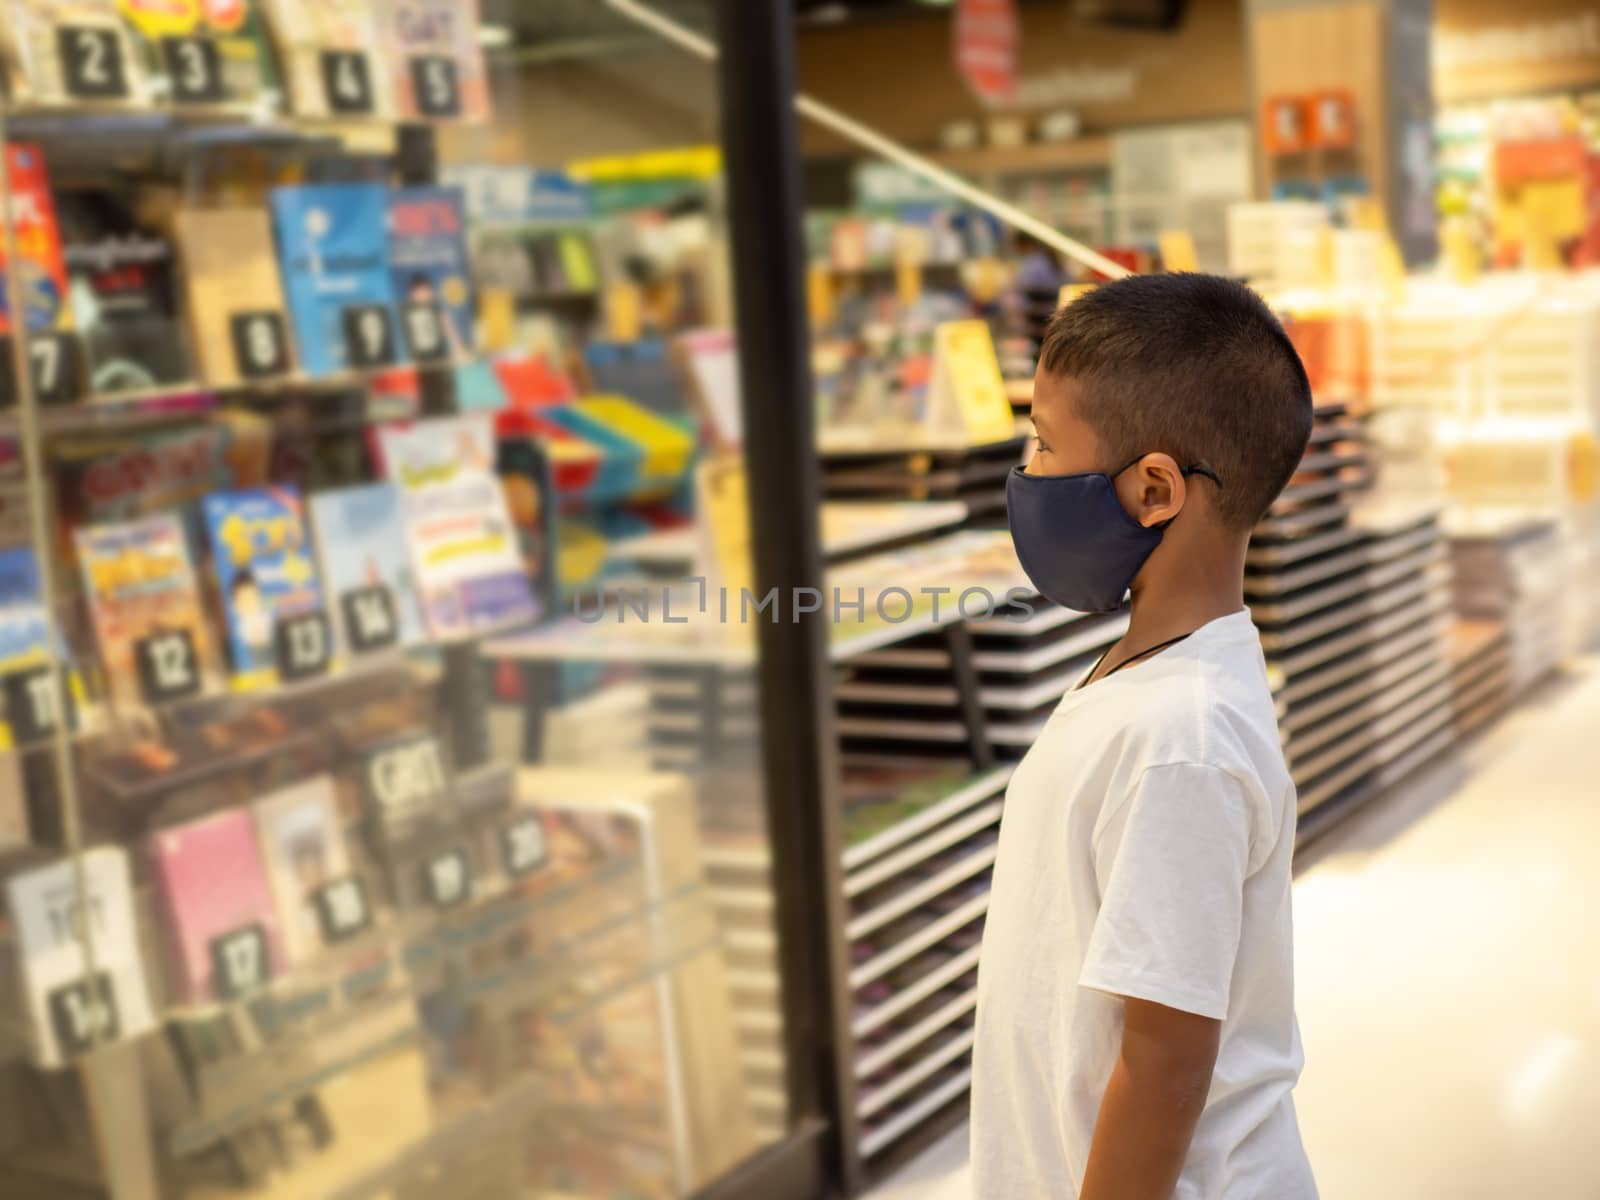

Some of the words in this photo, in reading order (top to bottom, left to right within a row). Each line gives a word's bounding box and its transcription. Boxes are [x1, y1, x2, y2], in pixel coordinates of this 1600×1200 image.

[77, 31, 108, 84] 2
[178, 40, 206, 91] 3
[336, 58, 360, 100] 4
[426, 64, 448, 107] 5
[247, 317, 278, 368] 8
[359, 310, 382, 358] 9
[31, 339, 59, 391] 7
[352, 592, 388, 640] 14
[151, 636, 188, 689] 12
[289, 618, 325, 666] 13
[508, 818, 544, 871] 20
[222, 931, 261, 984] 17
